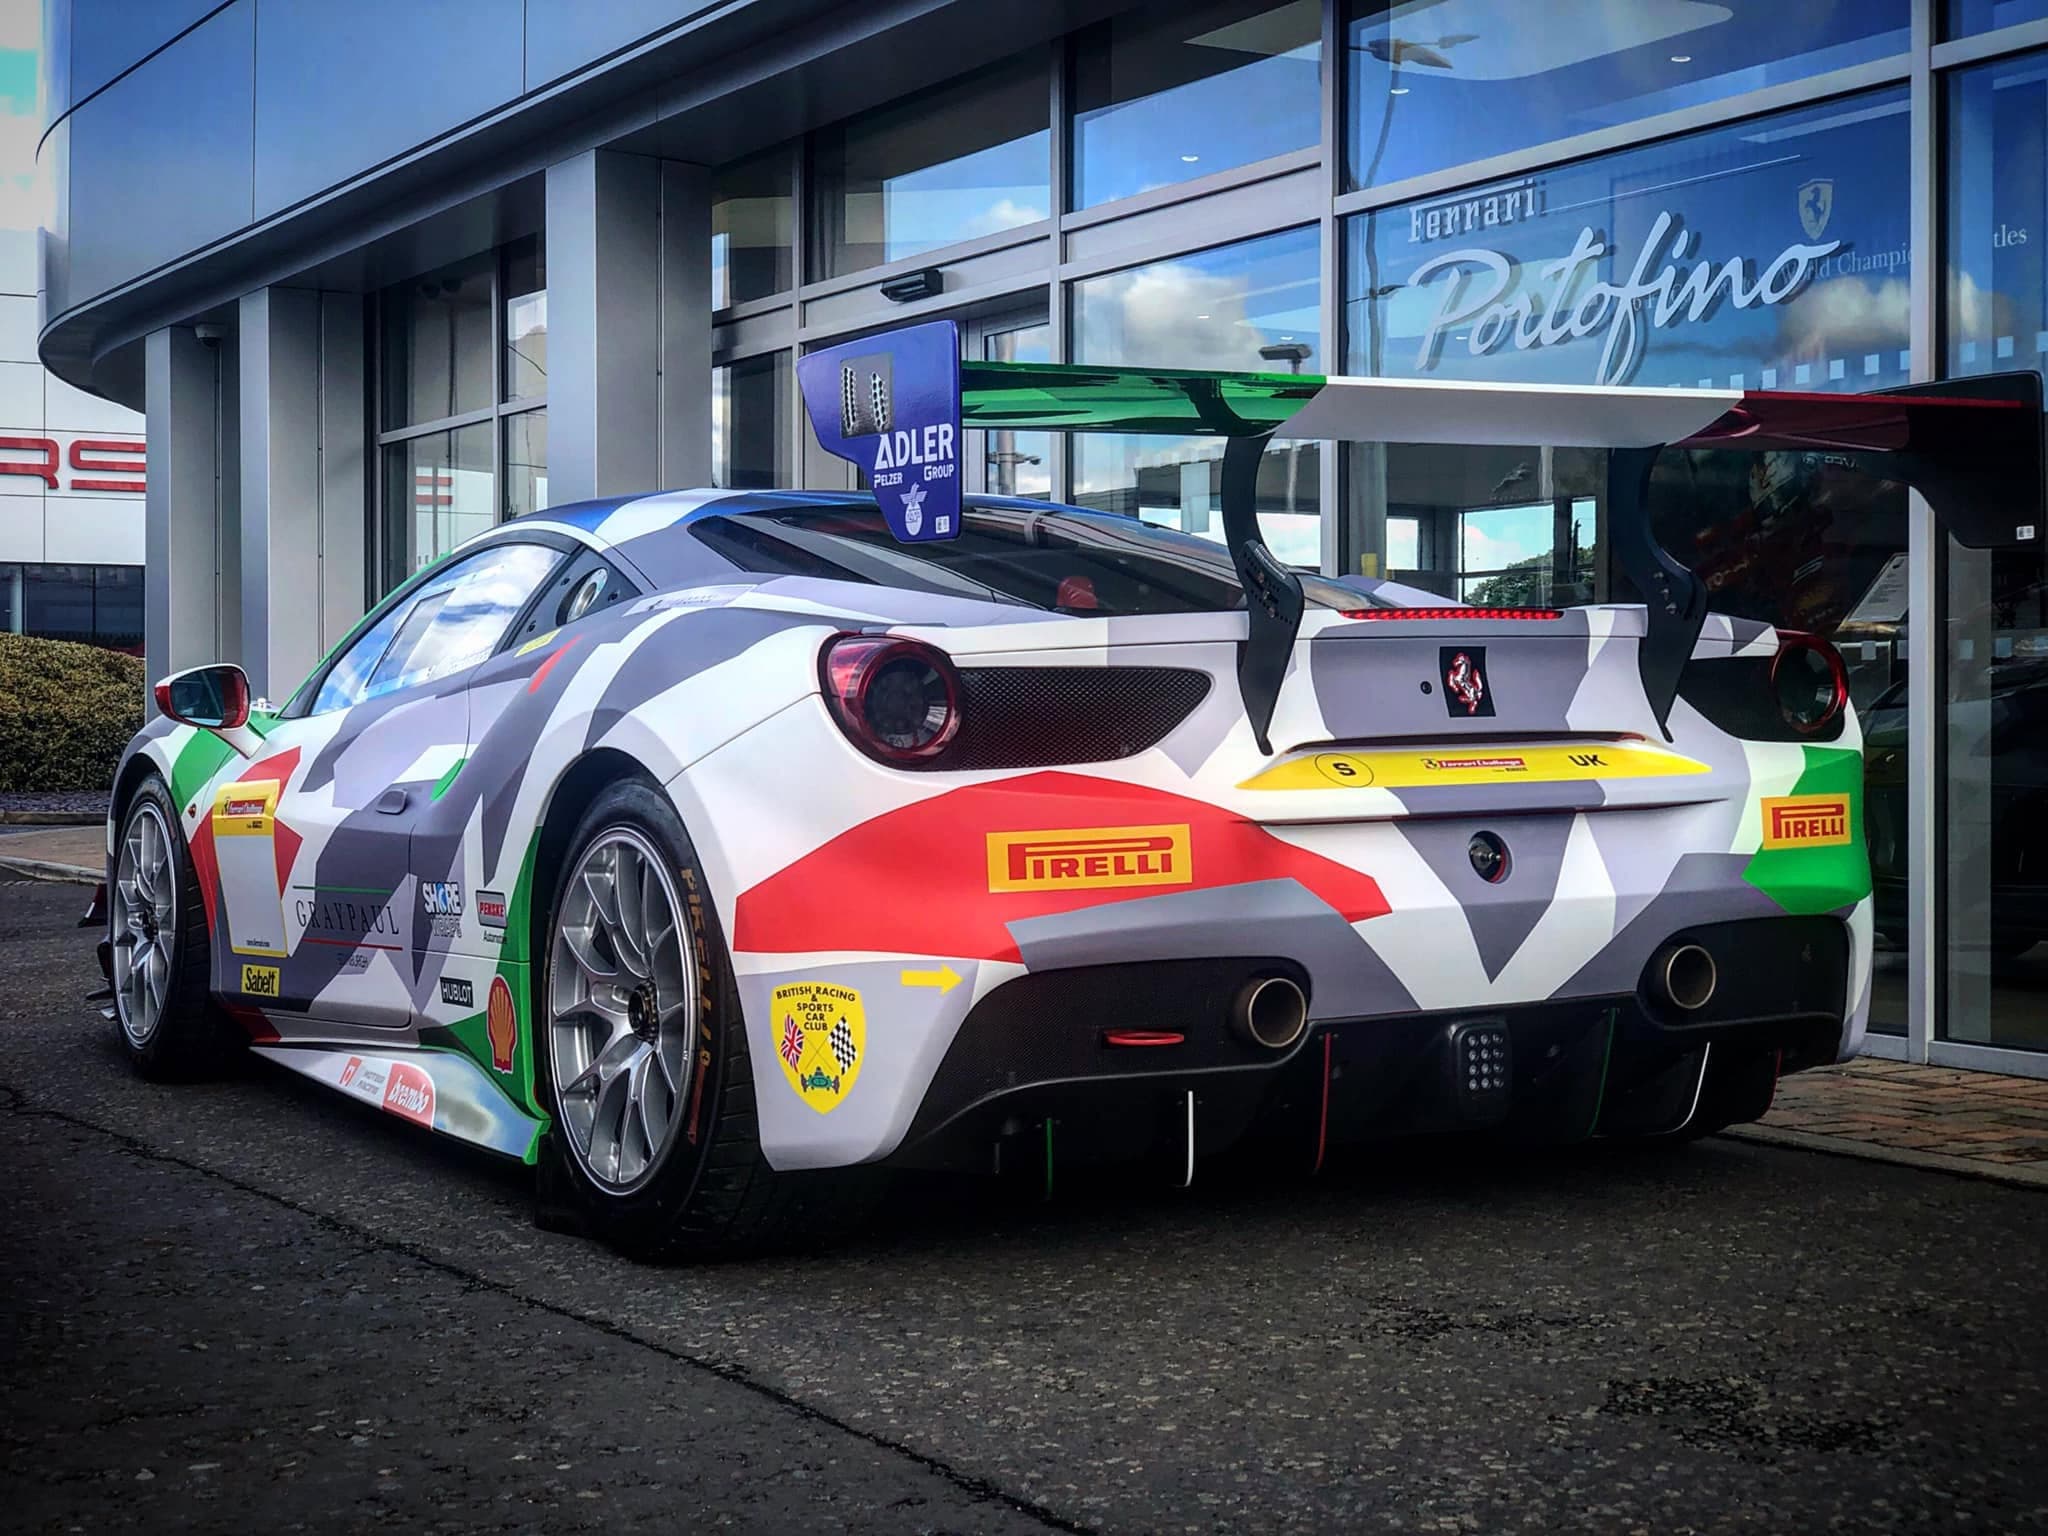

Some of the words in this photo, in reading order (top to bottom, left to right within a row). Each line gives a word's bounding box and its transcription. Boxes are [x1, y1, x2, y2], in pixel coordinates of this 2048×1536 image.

[1408, 178, 1534, 242] Ferrari
[1779, 255, 1830, 285] Wrld
[1407, 211, 1840, 386] Portofino
[874, 423, 954, 470] ADLER
[874, 472, 903, 488] PELZER
[924, 463, 954, 481] GROUP
[1333, 762, 1356, 776] S
[1568, 754, 1608, 766] UK
[1771, 803, 1844, 839] PIRELLI
[1008, 836, 1174, 881] PIRELLI
[422, 881, 462, 915] SHORE
[296, 900, 399, 935] GRAYPAUL
[442, 981, 471, 1003] HUBLOT
[776, 986, 812, 1000] BRITISH
[815, 986, 856, 1002] RACING
[796, 1002, 834, 1012] SPORTS
[805, 1012, 825, 1021] CAR
[803, 1022, 828, 1031] CLUB
